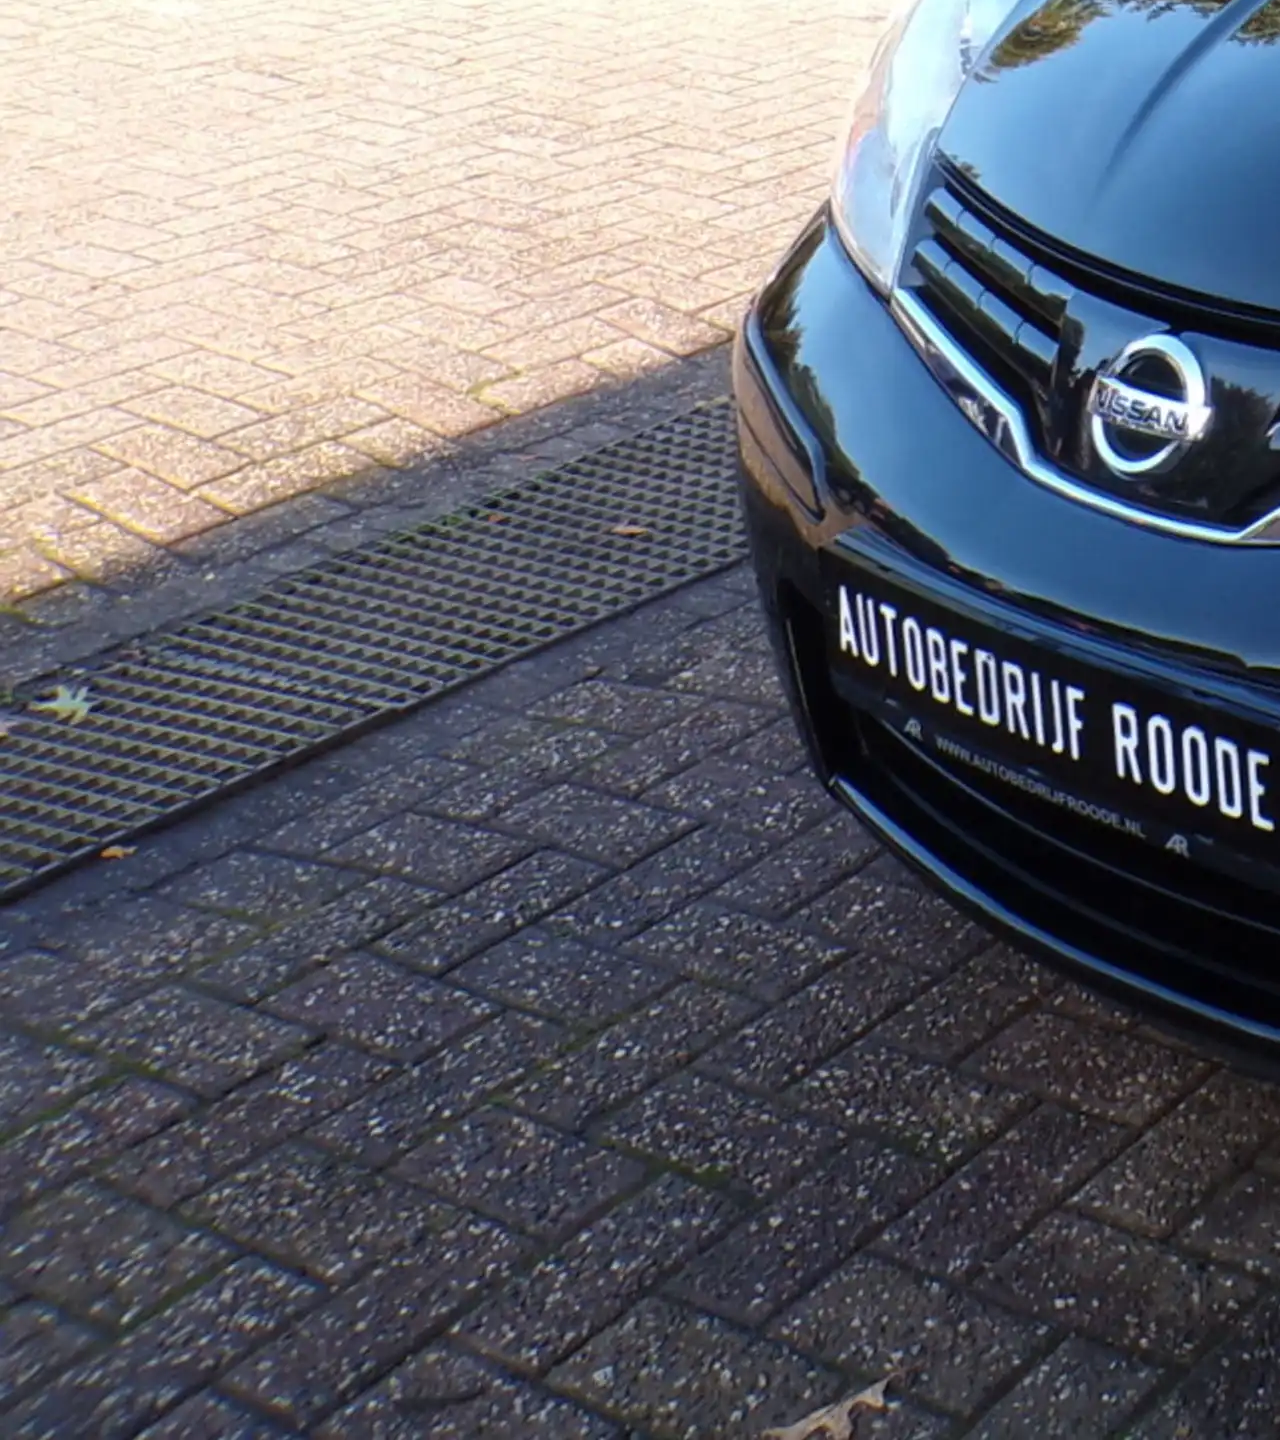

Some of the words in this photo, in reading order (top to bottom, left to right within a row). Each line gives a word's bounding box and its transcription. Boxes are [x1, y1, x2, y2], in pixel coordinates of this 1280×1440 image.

[1095, 384, 1189, 434] NISSAN
[838, 585, 1085, 760] AUTOBEDRIJF
[1112, 702, 1275, 831] ROODE
